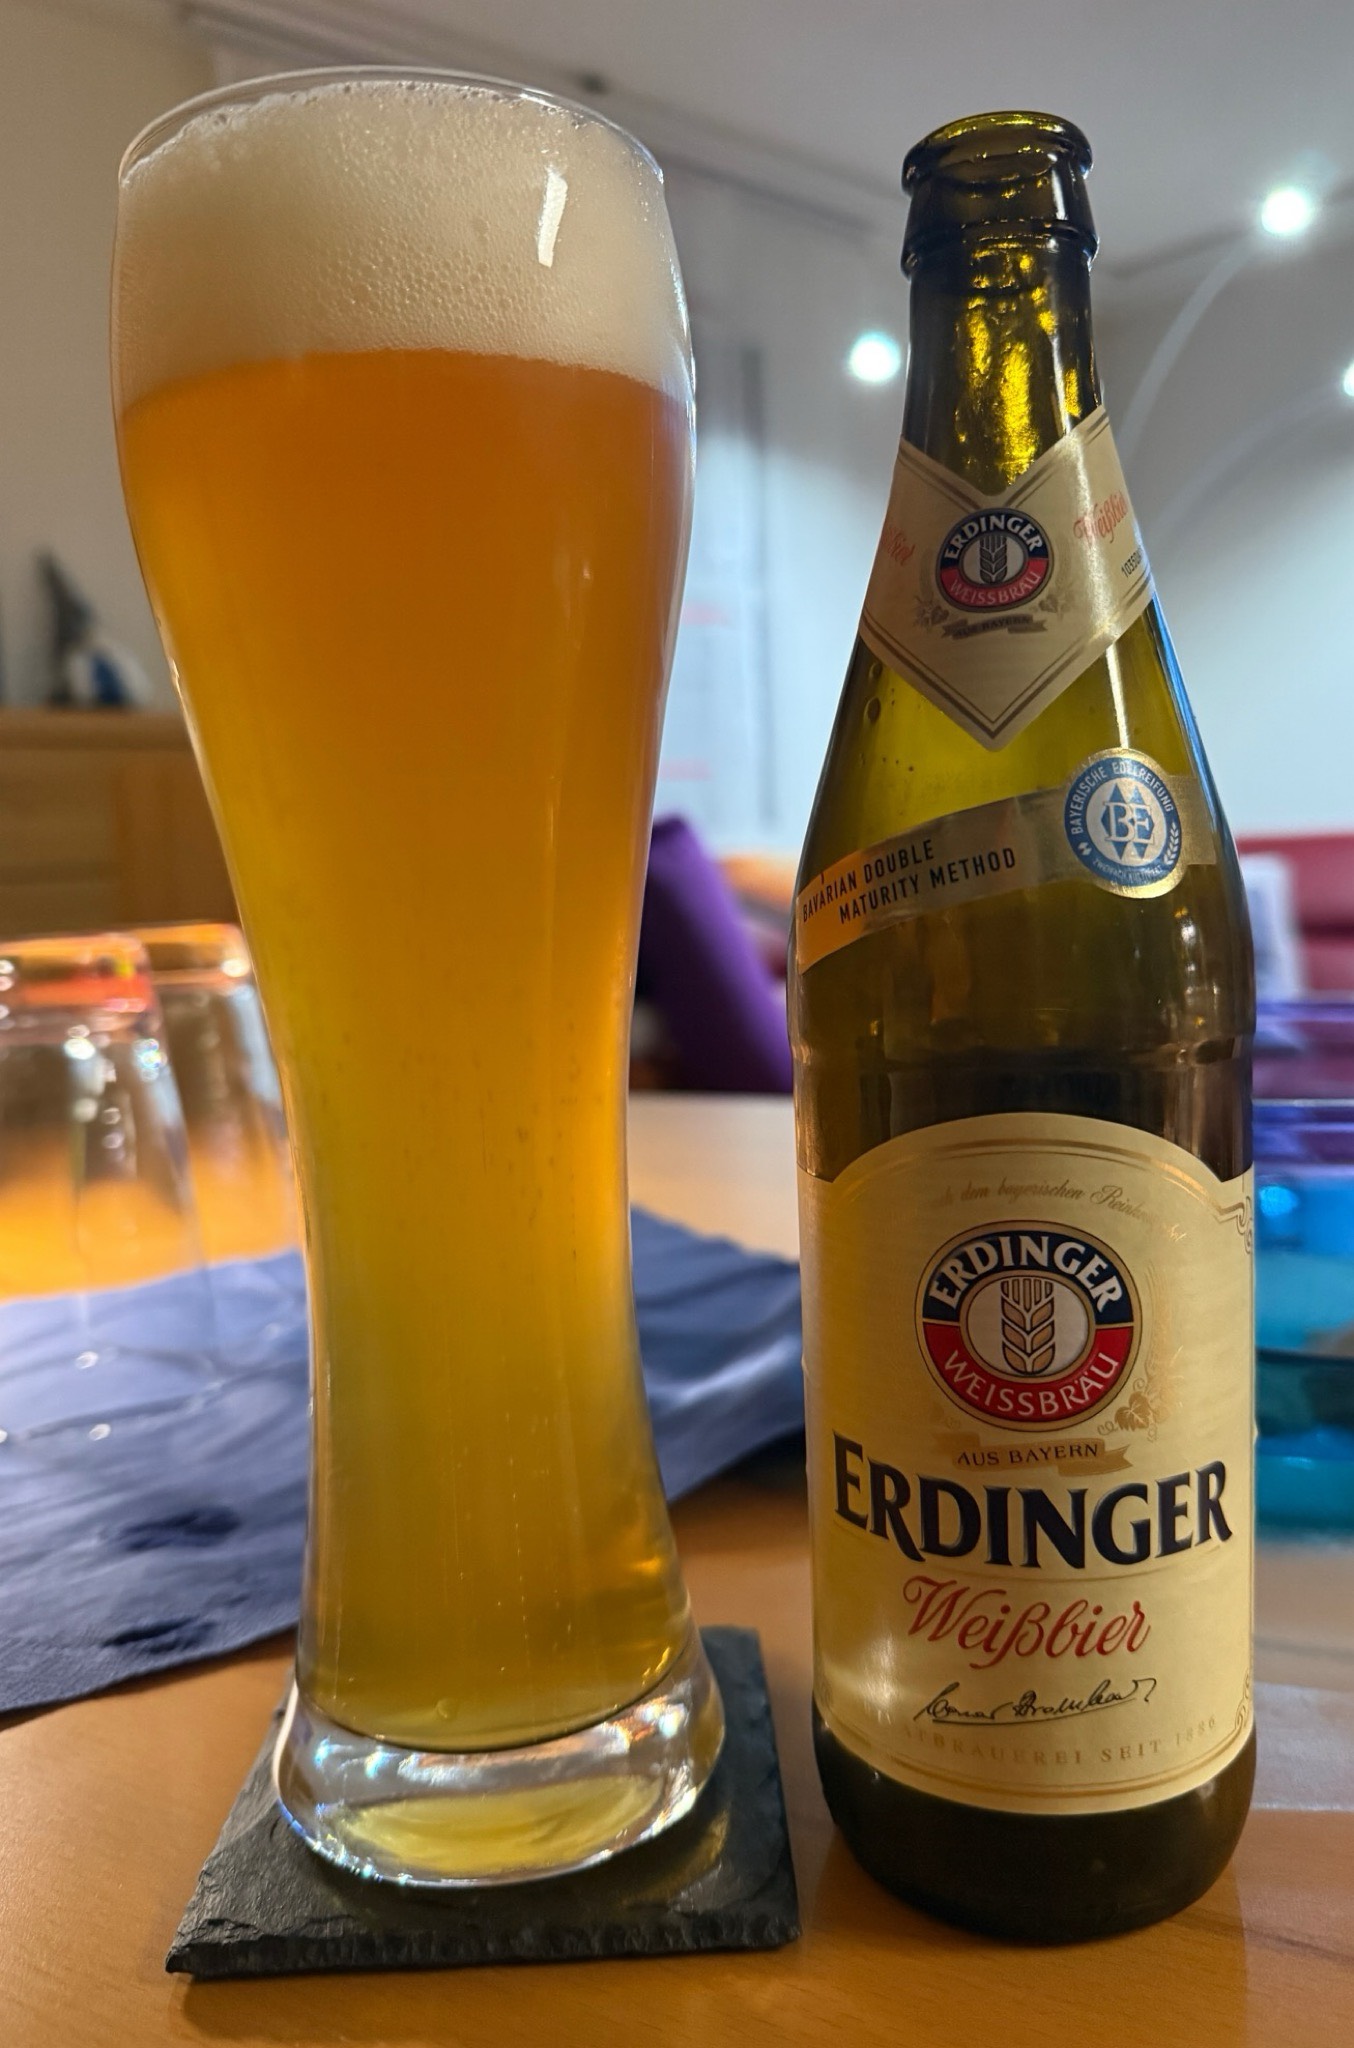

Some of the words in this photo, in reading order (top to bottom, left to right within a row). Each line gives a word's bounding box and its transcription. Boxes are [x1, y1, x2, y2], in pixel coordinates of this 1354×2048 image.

[944, 514, 1043, 559] ERDINGER
[1071, 766, 1108, 835] BAYERISCHE
[803, 870, 857, 922] BAVARIAN
[863, 839, 934, 883] DOUBLE
[839, 874, 920, 924] MATURITY
[929, 846, 1016, 888] METHOD
[928, 1235, 1124, 1312] ERDINGER
[944, 1350, 1120, 1416] WEISSBRÄU
[957, 1451, 1000, 1466] AUS
[1009, 1443, 1099, 1464] BAYERN
[833, 1430, 1233, 1569] ERDINGER
[902, 1575, 1152, 1670] Weißbier
[1101, 1738, 1160, 1763] SEIT
